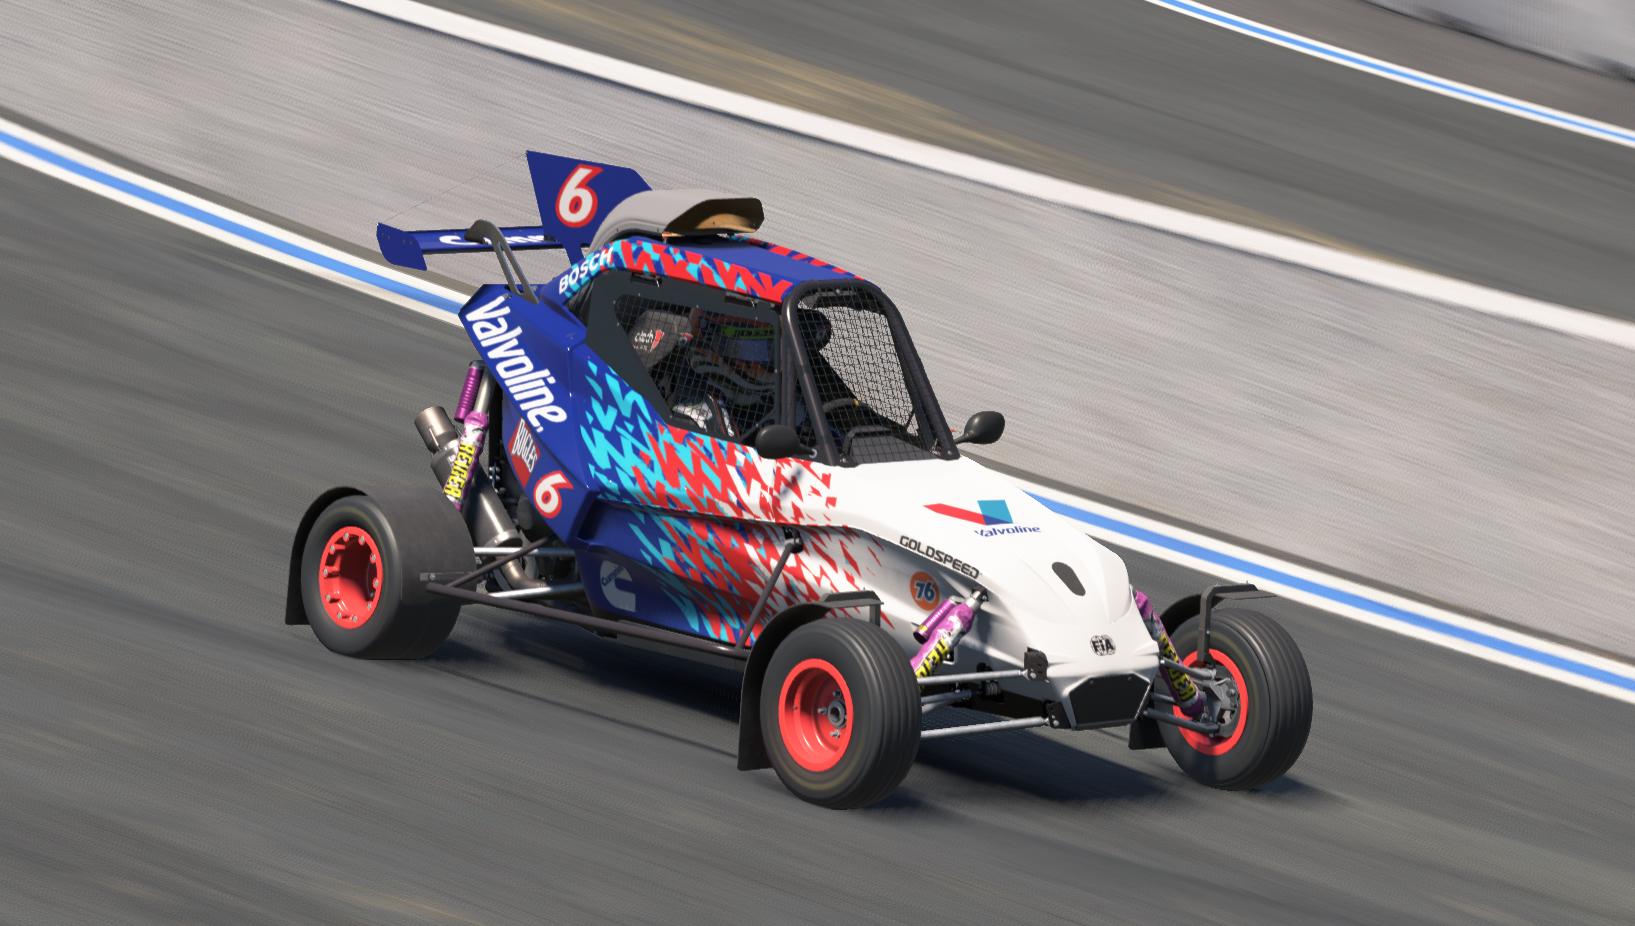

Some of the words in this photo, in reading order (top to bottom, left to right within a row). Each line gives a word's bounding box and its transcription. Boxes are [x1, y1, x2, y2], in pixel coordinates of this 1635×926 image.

[555, 164, 603, 228] 6
[559, 246, 614, 295] BOSCH
[533, 470, 574, 519] 6
[974, 526, 1042, 538] Valvoline
[899, 535, 981, 580] GOLDSPEED
[915, 581, 936, 602] 76
